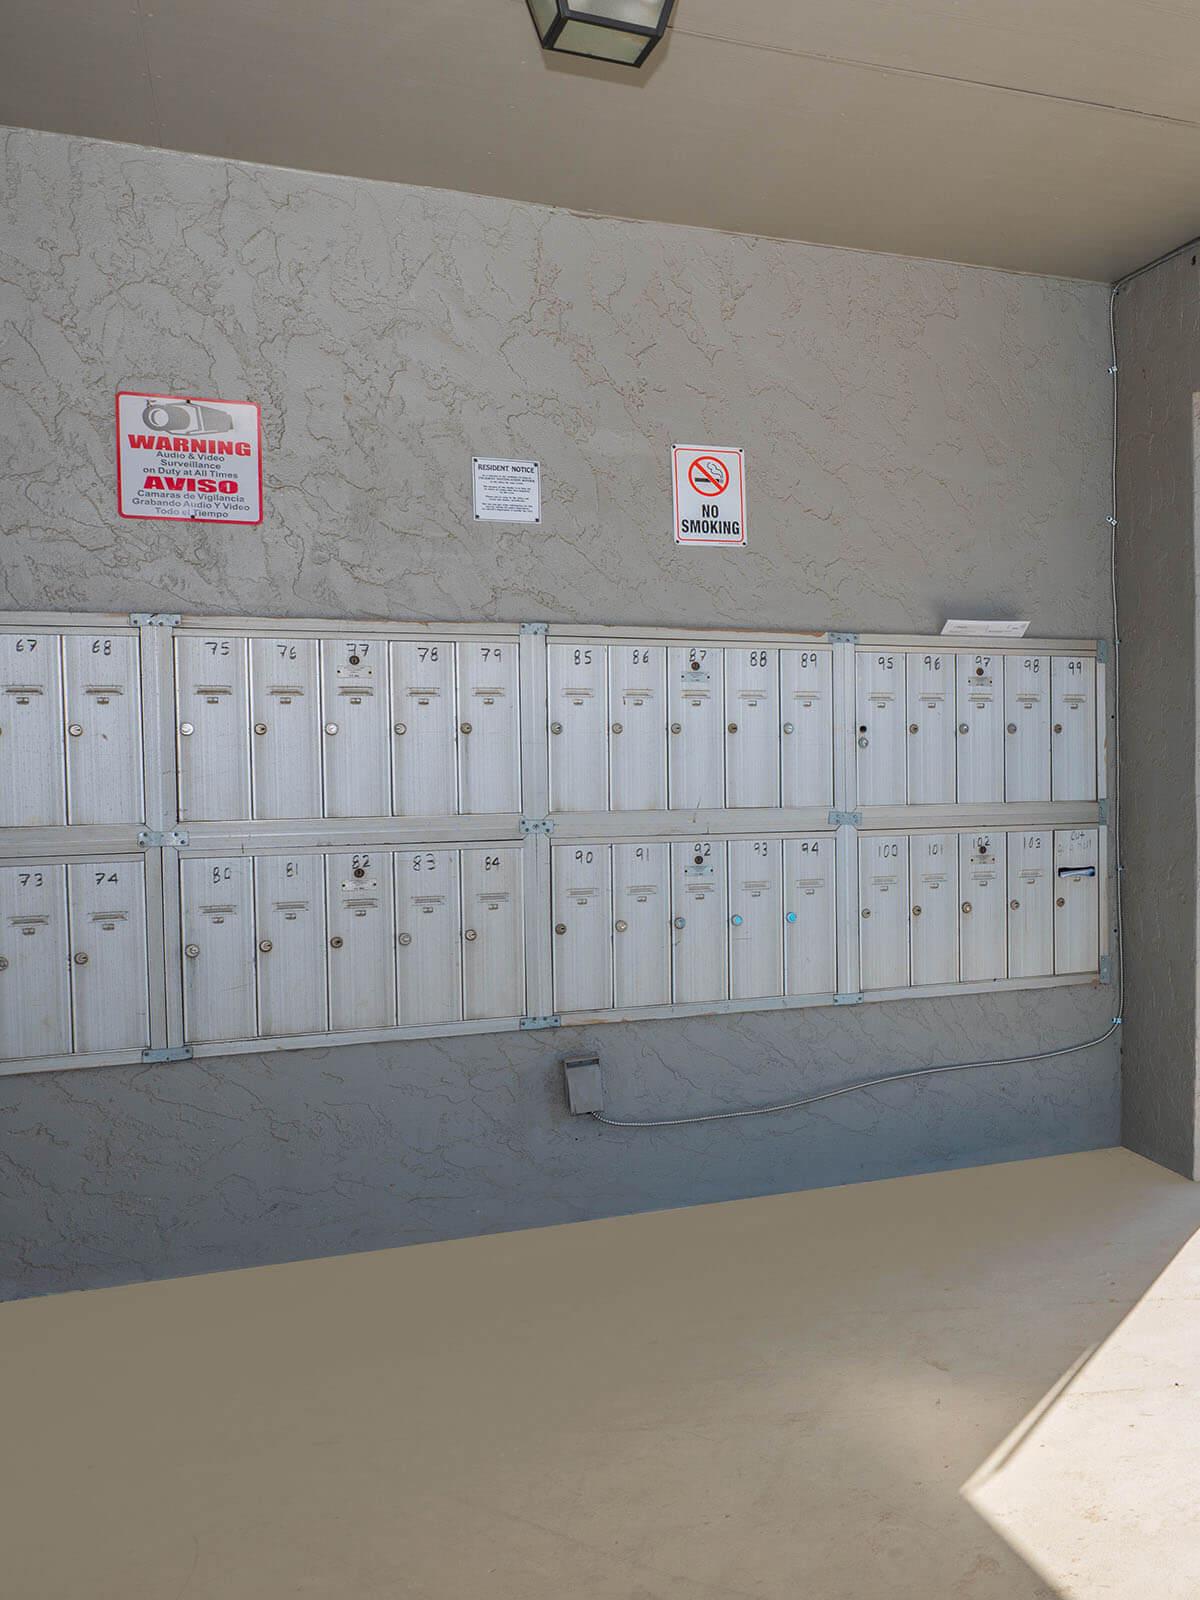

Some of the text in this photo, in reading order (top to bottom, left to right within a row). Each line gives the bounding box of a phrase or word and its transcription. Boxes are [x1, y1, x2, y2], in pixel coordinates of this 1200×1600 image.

[128, 435, 251, 456] WARNING
[156, 451, 185, 459] Audio
[197, 454, 225, 462] Video
[161, 459, 221, 469] Surveillance
[158, 468, 181, 476] Duty
[209, 470, 238, 479] Times
[144, 476, 238, 494] AVISO
[138, 490, 180, 499] Camaras
[197, 494, 245, 504] Vigilancia
[132, 498, 181, 507] Grabando
[223, 503, 250, 511] Video
[702, 504, 718, 518] NO
[194, 509, 229, 518] Tiempo
[681, 519, 739, 534] SMOKING
[15, 640, 38, 652] 67
[92, 640, 112, 655] 68
[206, 642, 230, 655] 75
[277, 645, 297, 659] 76
[346, 643, 370, 656] 77
[418, 647, 438, 662] 78
[481, 649, 501, 663] 79
[574, 650, 592, 665] 85
[633, 650, 649, 664] 86
[689, 649, 707, 662] 87
[750, 651, 768, 667] 88
[801, 653, 817, 668] 89
[878, 657, 893, 670] 95
[924, 656, 940, 670] 96
[975, 656, 991, 668] 97
[1024, 660, 1039, 673] 98
[1068, 662, 1082, 675] 99
[802, 842, 818, 855] 94
[973, 837, 990, 847] 102
[1023, 837, 1041, 849] 103
[637, 849, 650, 862] 91
[694, 843, 710, 856] 92
[754, 843, 768, 856] 93
[352, 855, 370, 868] 82
[413, 854, 434, 870] 83
[485, 856, 500, 871] 84
[576, 851, 593, 864] 90
[19, 874, 43, 887] 73
[96, 873, 118, 885] 74
